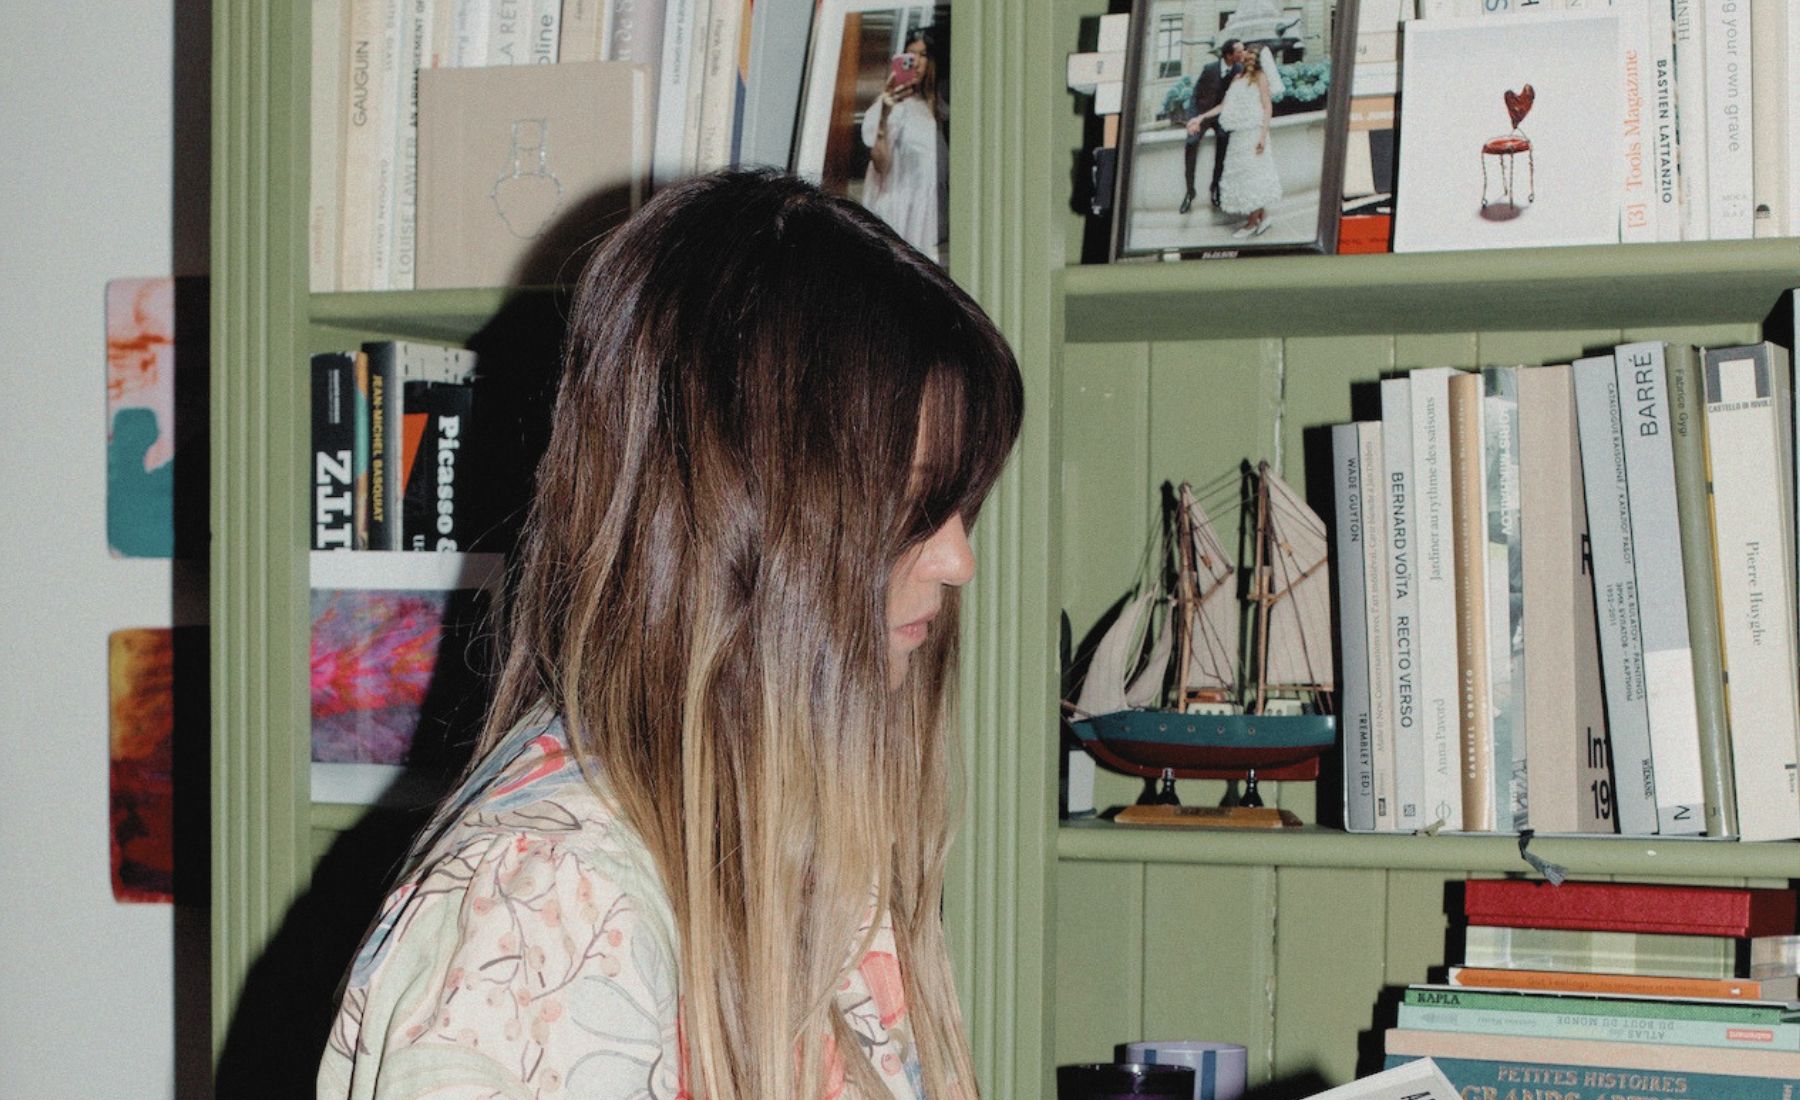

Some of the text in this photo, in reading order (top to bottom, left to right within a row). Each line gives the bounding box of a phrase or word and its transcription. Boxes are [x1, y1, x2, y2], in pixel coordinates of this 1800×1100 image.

[352, 40, 369, 127] GAUGUIN
[1722, 19, 1740, 153] your own grave
[1623, 49, 1648, 230] [3] Tools Magazine
[1656, 59, 1673, 204] BASTIEN LATTANZIO
[399, 137, 417, 275] LOUISE LAWLER
[1607, 382, 1619, 434] CATALOGUE
[1629, 352, 1659, 437] BARRÉ
[1675, 368, 1689, 437] Fabrice Gygi
[1708, 402, 1740, 413] CASTELLO
[372, 374, 383, 523] JEAN-MICHEL BASQUIAT
[436, 415, 460, 535] Picasso
[1423, 396, 1443, 581] Jardiner au rythme des saisons
[1347, 457, 1360, 543] WADE GUYTON
[1391, 472, 1411, 600] BERNARD VOÏTA
[1626, 580, 1635, 601] ERIK
[1628, 602, 1638, 642] BULATOV
[1746, 541, 1766, 646] Pierre Huyghe
[1397, 616, 1413, 728] RECTO VERSO
[1632, 652, 1644, 701] PAINTINGS
[1359, 712, 1370, 766] TREMBLEY
[1433, 698, 1448, 775] Anna Pavord
[1465, 669, 1477, 779] GABRIEL OROZCO
[1417, 992, 1461, 1005] KAPLA
[1556, 1016, 1675, 1031] DU BOUT DU MONDE
[1626, 1030, 1666, 1041] ATLAS
[1497, 1065, 1688, 1094] PETITES HISTOIRES
